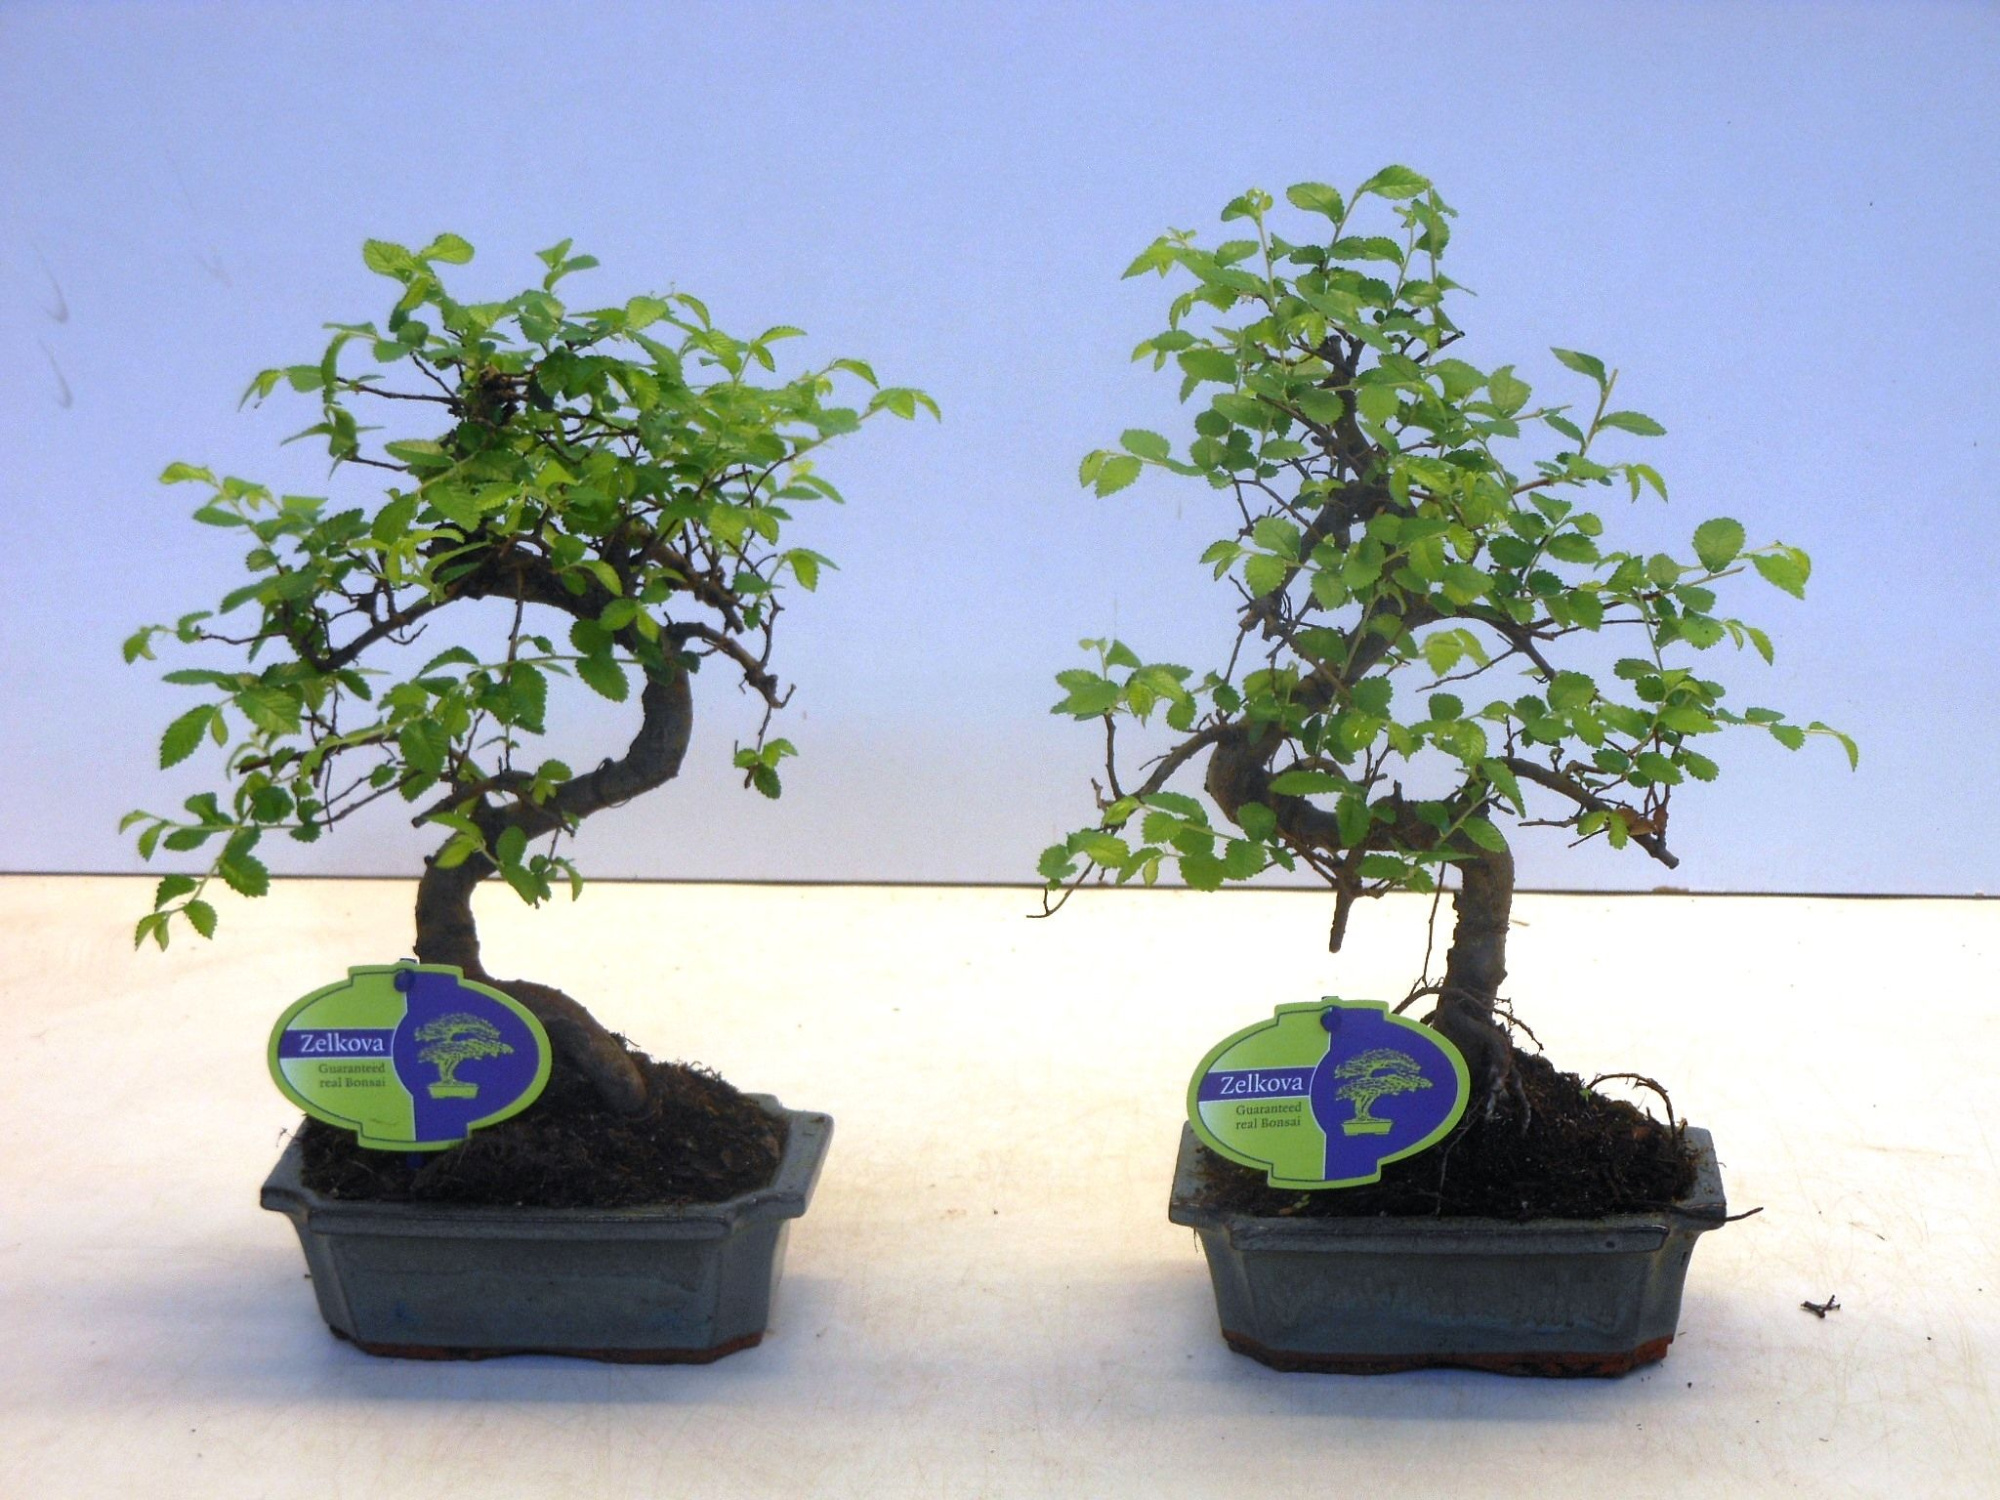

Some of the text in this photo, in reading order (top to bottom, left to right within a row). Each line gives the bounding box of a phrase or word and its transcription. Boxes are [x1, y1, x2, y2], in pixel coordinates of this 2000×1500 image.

[300, 1032, 385, 1053] Zelkova
[318, 1063, 386, 1074] Guaranteed
[319, 1077, 386, 1088] real Bonsai
[1220, 1073, 1304, 1095] Zelkova
[1235, 1101, 1302, 1116] Guaranteed
[1236, 1116, 1301, 1130] real Bonsai
